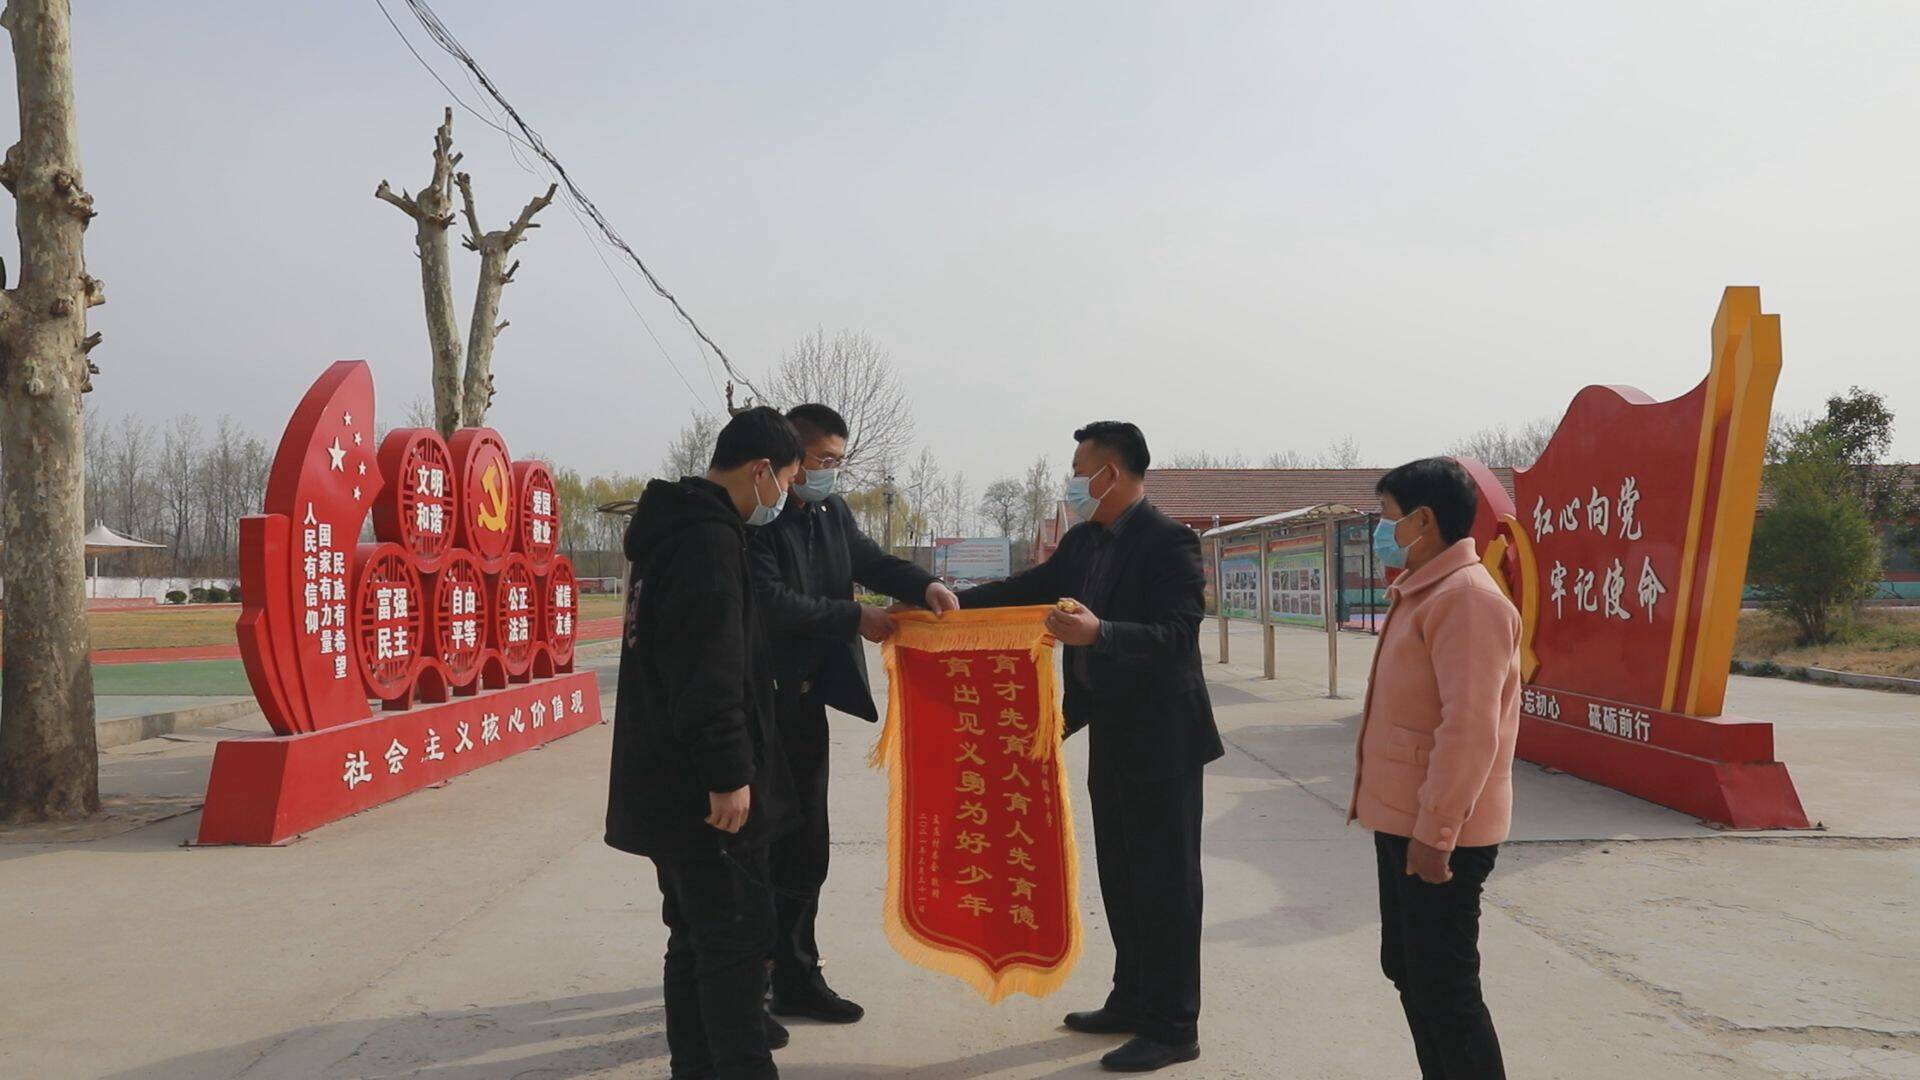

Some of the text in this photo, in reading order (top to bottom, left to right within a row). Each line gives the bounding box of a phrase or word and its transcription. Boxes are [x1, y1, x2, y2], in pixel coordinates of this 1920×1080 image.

[416, 465, 443, 498] 文明
[416, 502, 444, 536] 和谐
[532, 490, 552, 515] 爱国
[1532, 476, 1643, 544] 红心向党
[532, 520, 552, 546] 敬业
[304, 502, 319, 635] 人民有信仰
[318, 523, 333, 655] 国家有力量
[376, 587, 408, 621] 富强
[452, 585, 476, 615] 自由
[508, 586, 529, 612] 公正
[555, 584, 572, 609] 诚信
[1551, 556, 1666, 623] 牢记使命
[333, 551, 348, 680] 民族有希望
[508, 613, 529, 642] 法治
[555, 610, 572, 635] 友善
[376, 626, 409, 660] 民主
[451, 620, 477, 650] 平等
[1519, 689, 1560, 720] 忘初心
[1588, 703, 1651, 742] 砥砺前行
[342, 690, 584, 790] 社会主义核心价值观
[938, 656, 995, 918] 育出见义勇为好少年
[987, 654, 1039, 931] 育才先育人育人先育德
